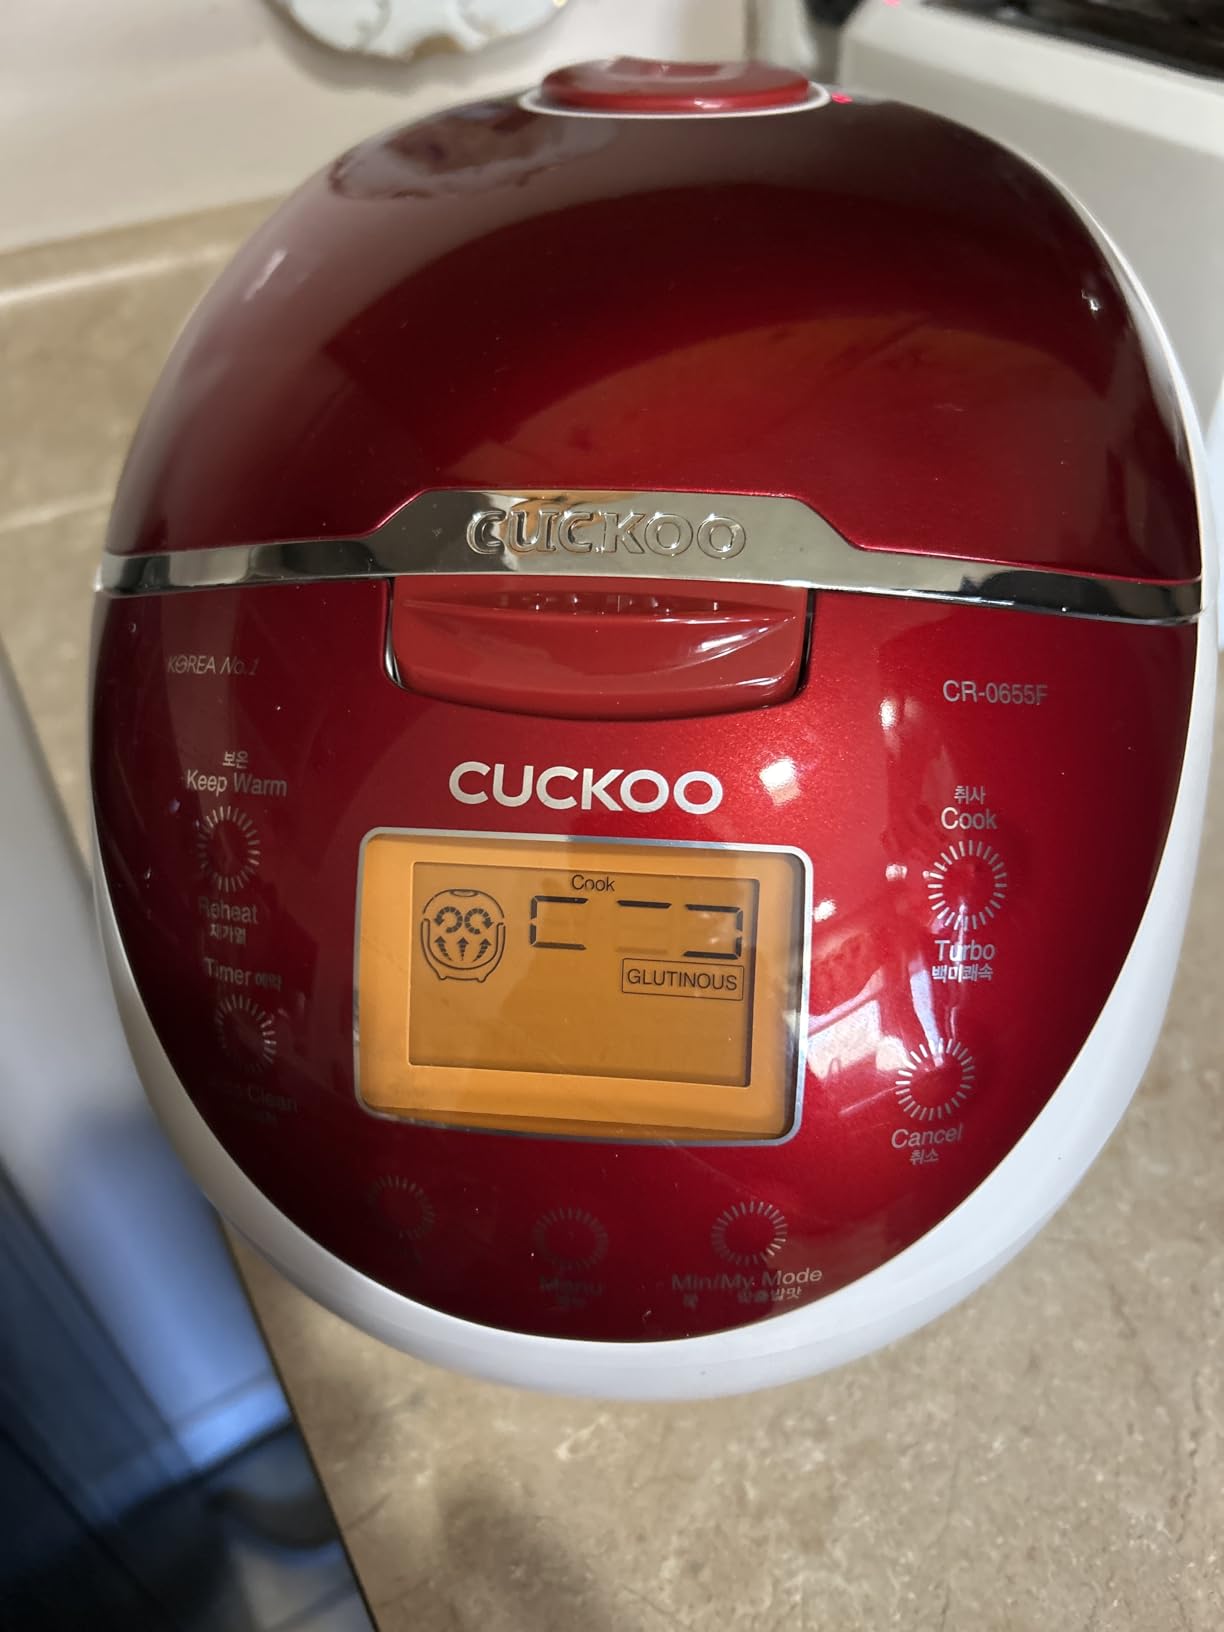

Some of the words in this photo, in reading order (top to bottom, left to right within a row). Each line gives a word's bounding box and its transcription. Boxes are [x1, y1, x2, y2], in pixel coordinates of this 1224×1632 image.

[466, 508, 746, 559] CUCKOO
[167, 655, 216, 675] KOREA
[942, 679, 1048, 705] CR-0655F
[222, 750, 249, 769] 보온
[186, 768, 228, 797] Keep
[233, 771, 288, 797] Warm
[448, 760, 724, 815] CUCKOO
[954, 785, 986, 805] 취사
[940, 806, 998, 830] Cook
[571, 873, 616, 893] Cook
[199, 896, 259, 925] Reheat
[934, 939, 996, 962] Turbo
[203, 957, 251, 987] Timer
[625, 967, 739, 992] GLUTINOUS
[931, 962, 993, 984] 백미쾌속
[891, 1122, 964, 1149] Cancel
[910, 1148, 940, 1166] 취소
[762, 1267, 823, 1286] Mode
